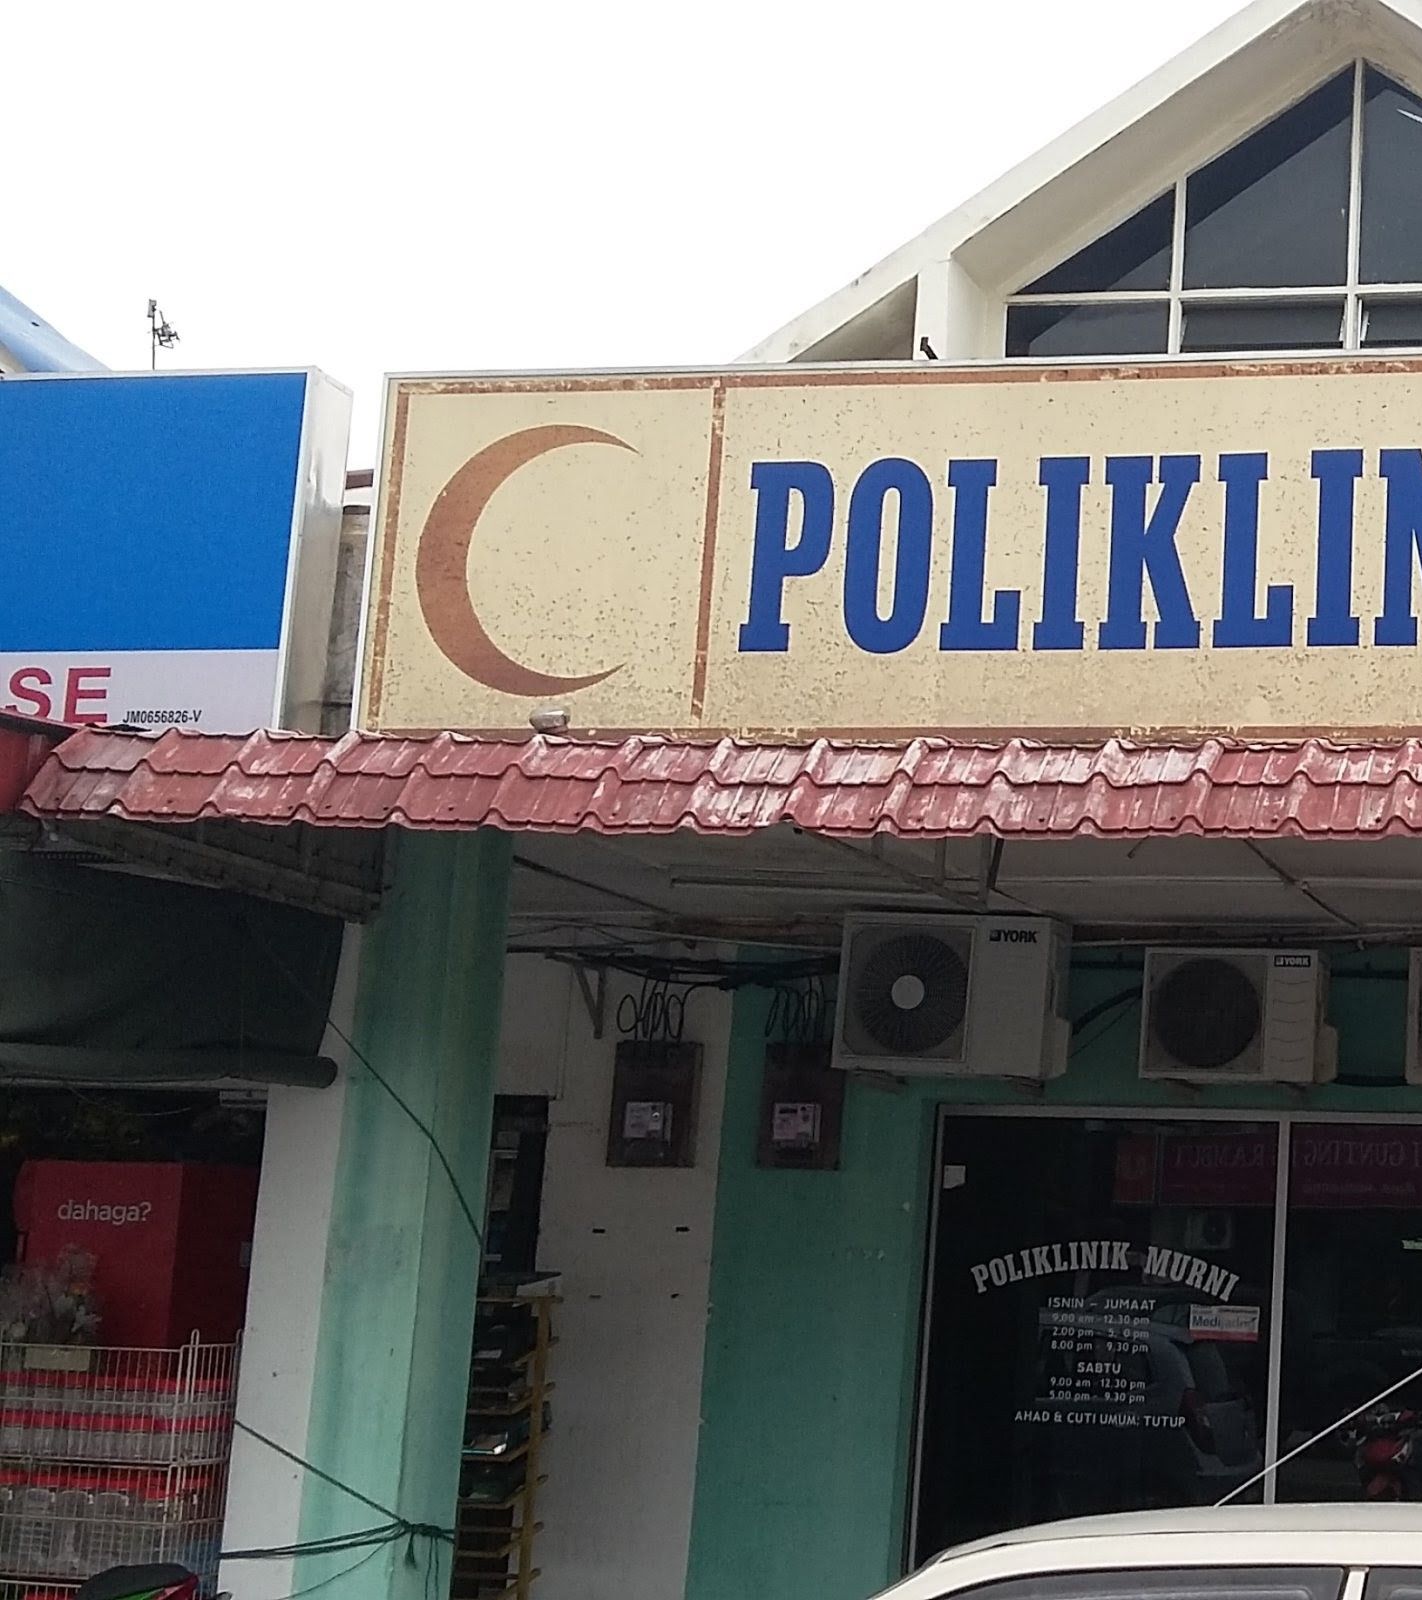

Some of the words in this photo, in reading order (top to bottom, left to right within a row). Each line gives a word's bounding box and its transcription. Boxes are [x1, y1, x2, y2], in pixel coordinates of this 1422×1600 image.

[7, 667, 111, 724] SE
[122, 709, 202, 725] JM0656826-V
[1001, 929, 1040, 943] YORK
[1283, 956, 1310, 967] YORK
[57, 1199, 152, 1226] dahaga?
[970, 1241, 1131, 1294] POLIKLINIK
[1143, 1244, 1241, 1302] MURNI
[1047, 1296, 1085, 1309] ISNIN
[1103, 1298, 1157, 1311] JUMAAT
[1051, 1312, 1075, 1323] 9.00
[1077, 1315, 1094, 1324] am
[1103, 1313, 1131, 1325] 12.30
[1132, 1316, 1151, 1327] pm
[1051, 1326, 1075, 1338] 2.00
[1076, 1328, 1094, 1339] pm
[1132, 1330, 1150, 1341] pm
[1050, 1340, 1074, 1351] 8.00
[1076, 1342, 1093, 1353] pm
[1106, 1341, 1130, 1352] 9.30
[1131, 1344, 1149, 1355] pm
[1076, 1361, 1122, 1375] SABTU
[1049, 1376, 1073, 1387] 9.00
[1074, 1379, 1091, 1388] am
[1099, 1377, 1127, 1389] 12.30
[1129, 1380, 1146, 1391] pm
[1048, 1390, 1072, 1401] 5.00
[1073, 1392, 1091, 1403] pm
[1103, 1391, 1127, 1402] 9.30
[1128, 1394, 1145, 1405] pm
[1013, 1410, 1050, 1423] AHAD
[1053, 1411, 1063, 1423] &
[1066, 1411, 1097, 1424] CUTI
[1143, 1414, 1186, 1428] TUTUP
